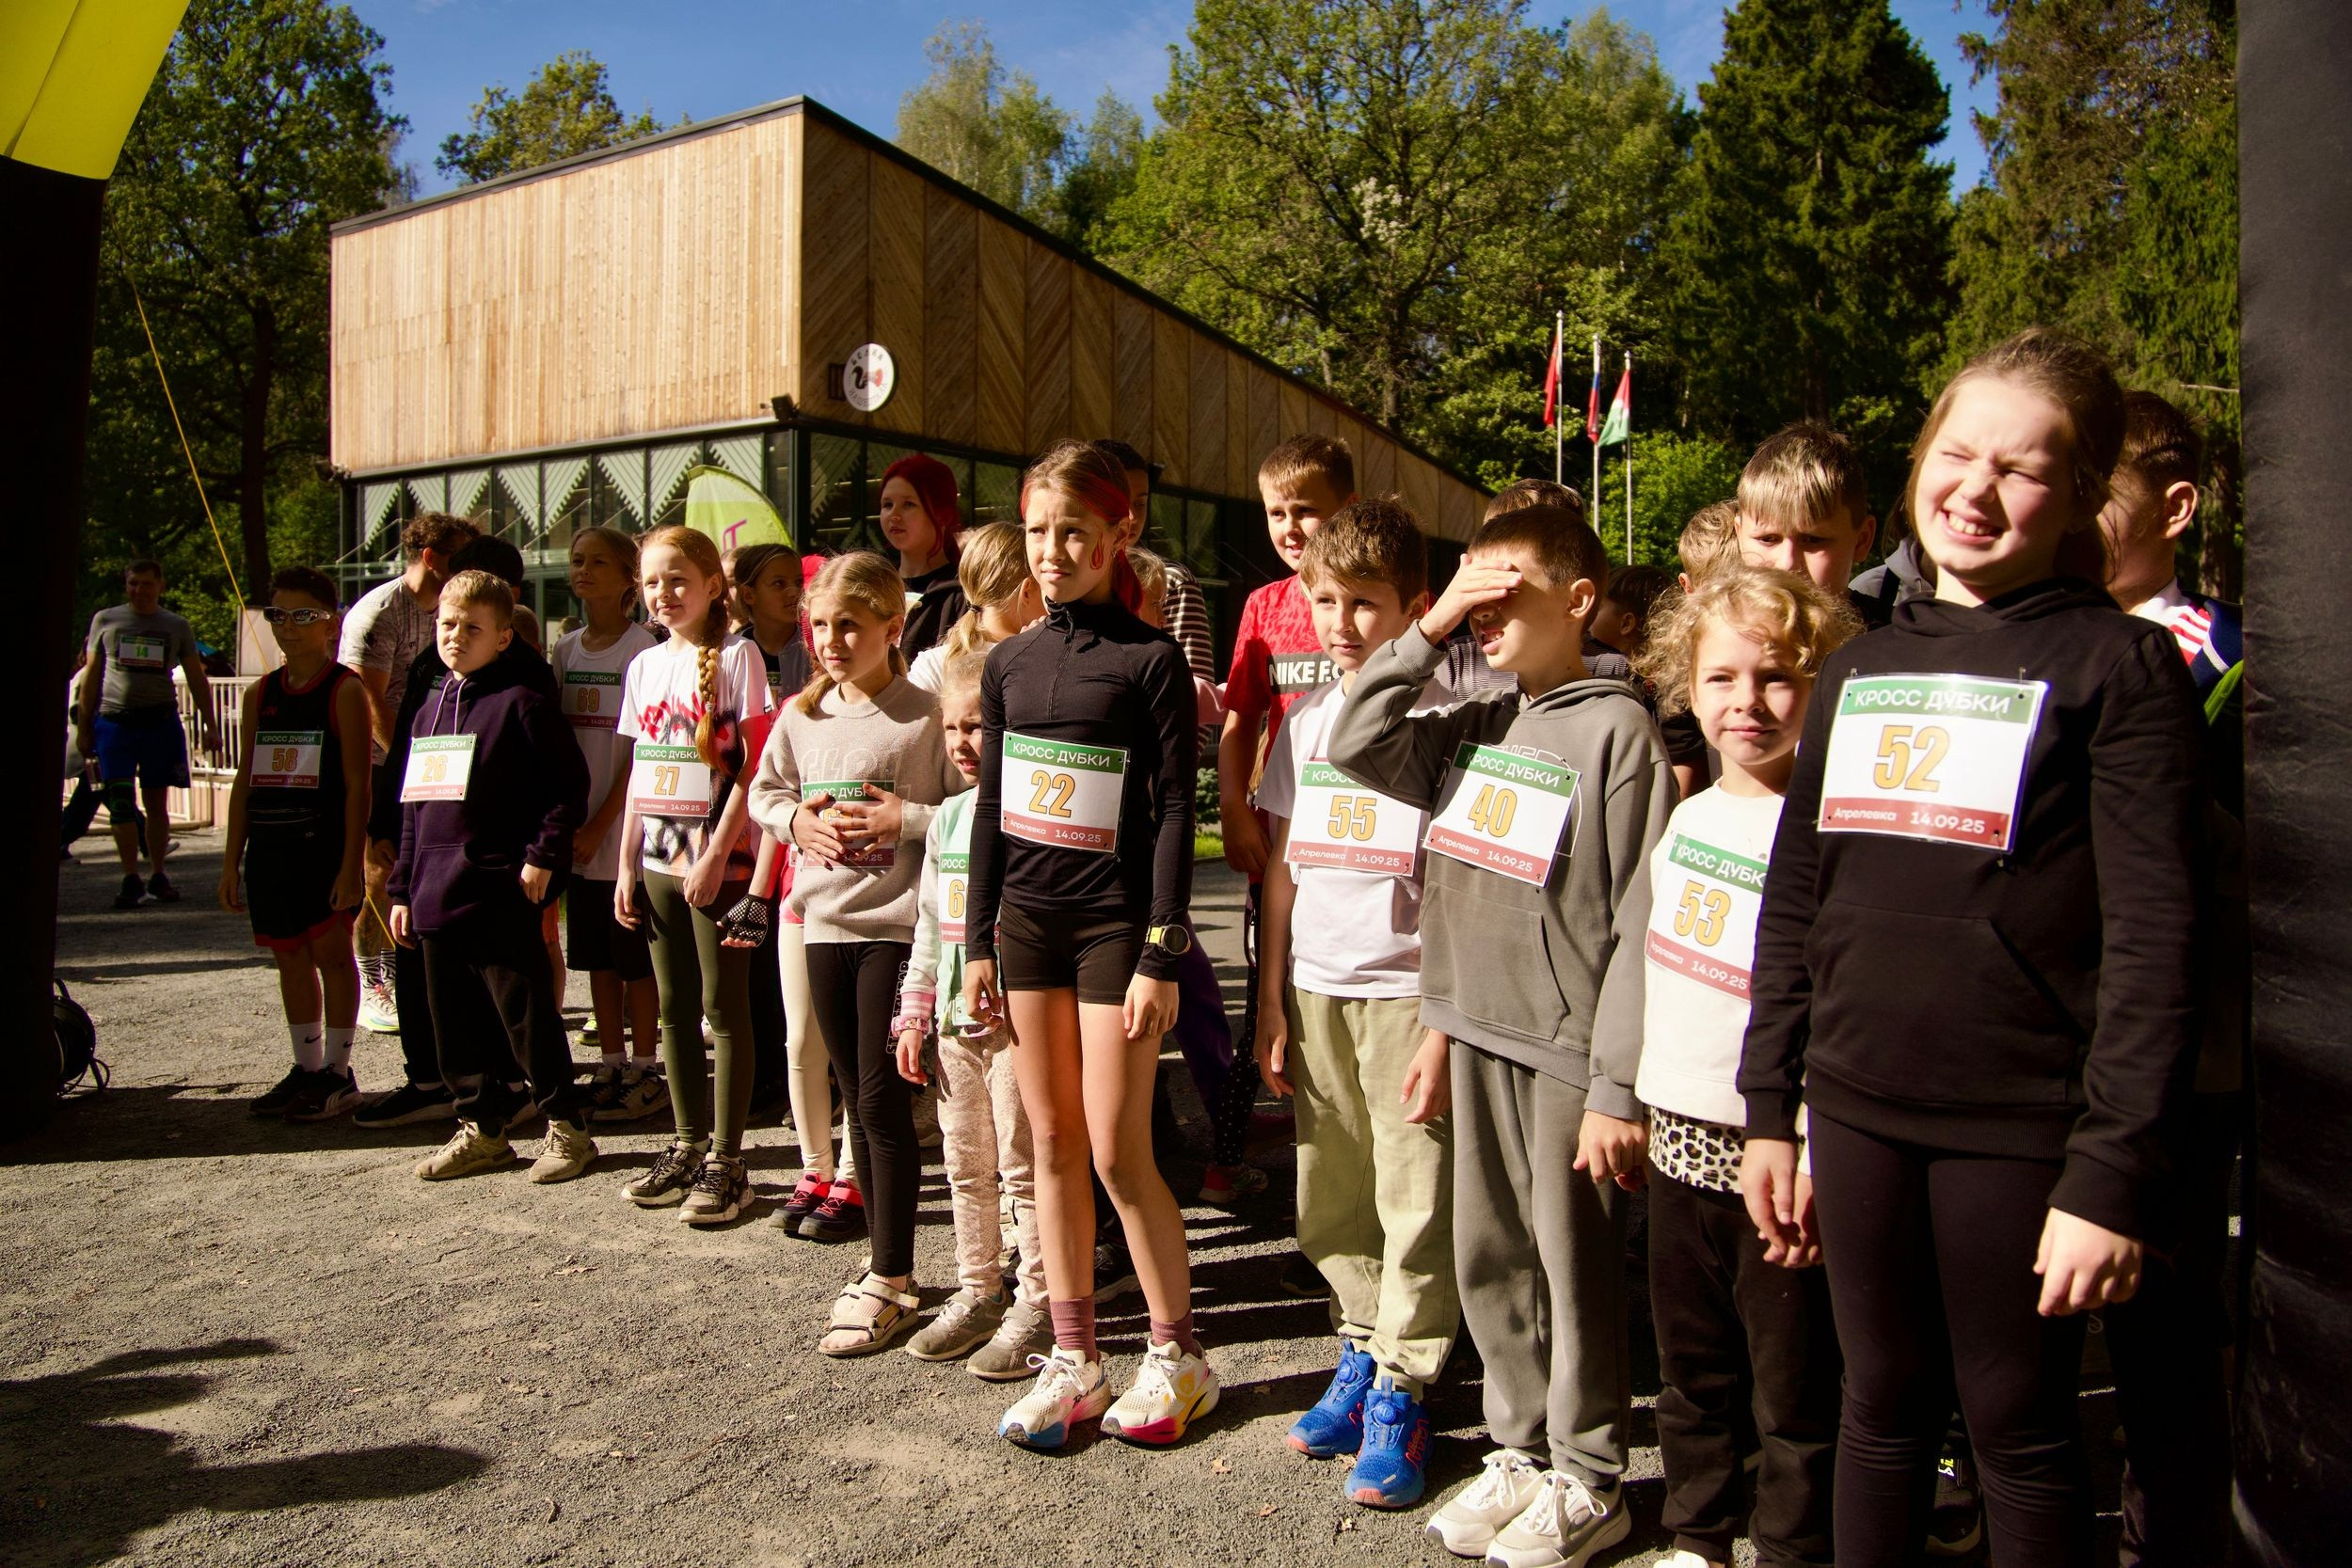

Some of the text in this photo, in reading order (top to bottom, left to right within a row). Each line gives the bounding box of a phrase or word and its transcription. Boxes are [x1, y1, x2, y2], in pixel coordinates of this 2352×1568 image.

[1268, 661, 1315, 687] NIKE
[577, 687, 600, 713] 69
[1854, 689, 2010, 714] КРОСС ДУБКИ
[271, 747, 298, 772] 58
[640, 749, 666, 758] КРОСС
[1013, 742, 1110, 768] КРОСС ДУБКИ
[1873, 724, 1950, 793] 52
[421, 754, 449, 783] 26
[654, 765, 680, 796] 27
[1465, 752, 1505, 772] КРОСС
[1505, 763, 1561, 788] ДУБКИ
[670, 803, 701, 812] 14.09.25
[1028, 769, 1076, 818] 22
[1327, 794, 1377, 842] 55
[1468, 783, 1518, 838] 40
[1834, 806, 1985, 835] Апрелевка 14.09.25
[1055, 829, 1102, 843] 14.09.25
[1298, 847, 1400, 867] Апрелевка 14.09.25
[1438, 834, 1534, 872] Апрелевка 14.09.25
[1677, 843, 1767, 888] КРОСС ДУБК
[1674, 879, 1732, 947] 53
[1691, 960, 1749, 990] 14.09.25
